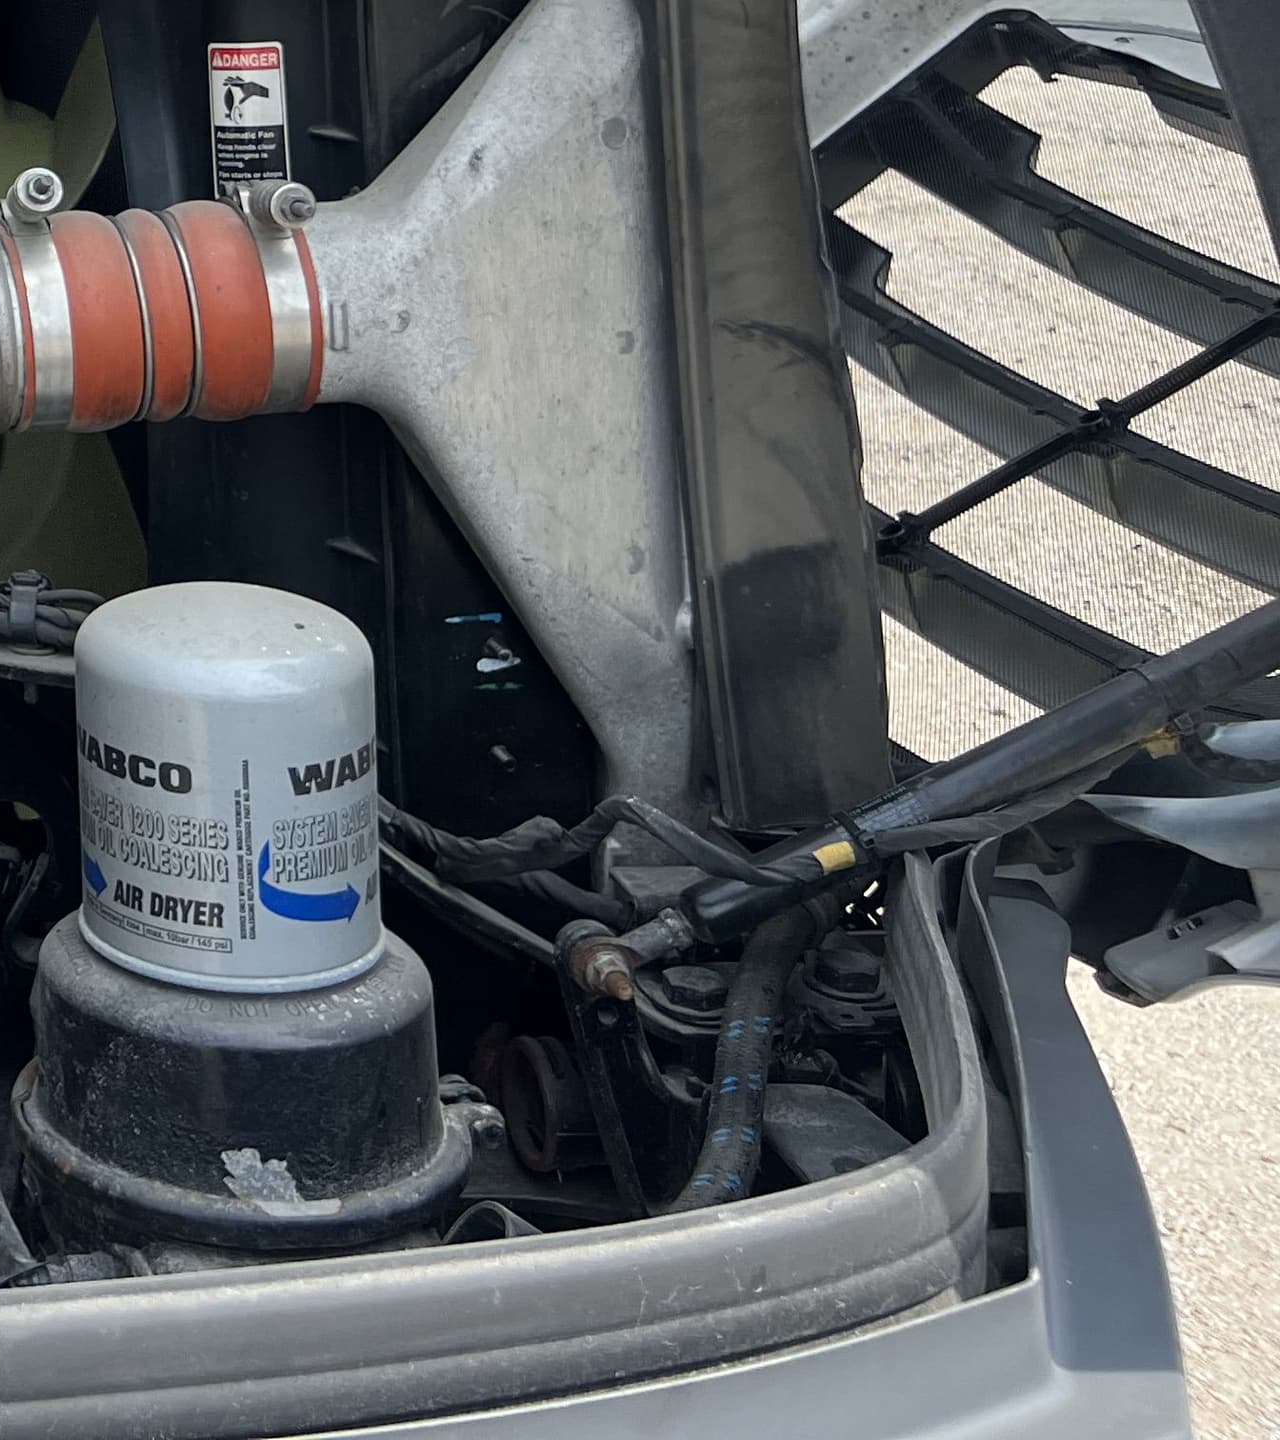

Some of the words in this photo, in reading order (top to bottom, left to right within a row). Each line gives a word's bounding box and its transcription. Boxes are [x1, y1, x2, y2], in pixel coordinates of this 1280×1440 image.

[222, 53, 278, 67] DANGER
[217, 131, 256, 139] Automatic
[127, 802, 165, 841] 1200
[167, 814, 229, 851] SERIES
[272, 810, 338, 851] SYSTEM
[120, 836, 230, 884] COALESCING
[271, 841, 349, 883] PREMIUM
[113, 879, 144, 913] AIR
[150, 891, 225, 929] DRYER
[186, 994, 214, 1014] DO
[228, 1001, 271, 1019] NOT
